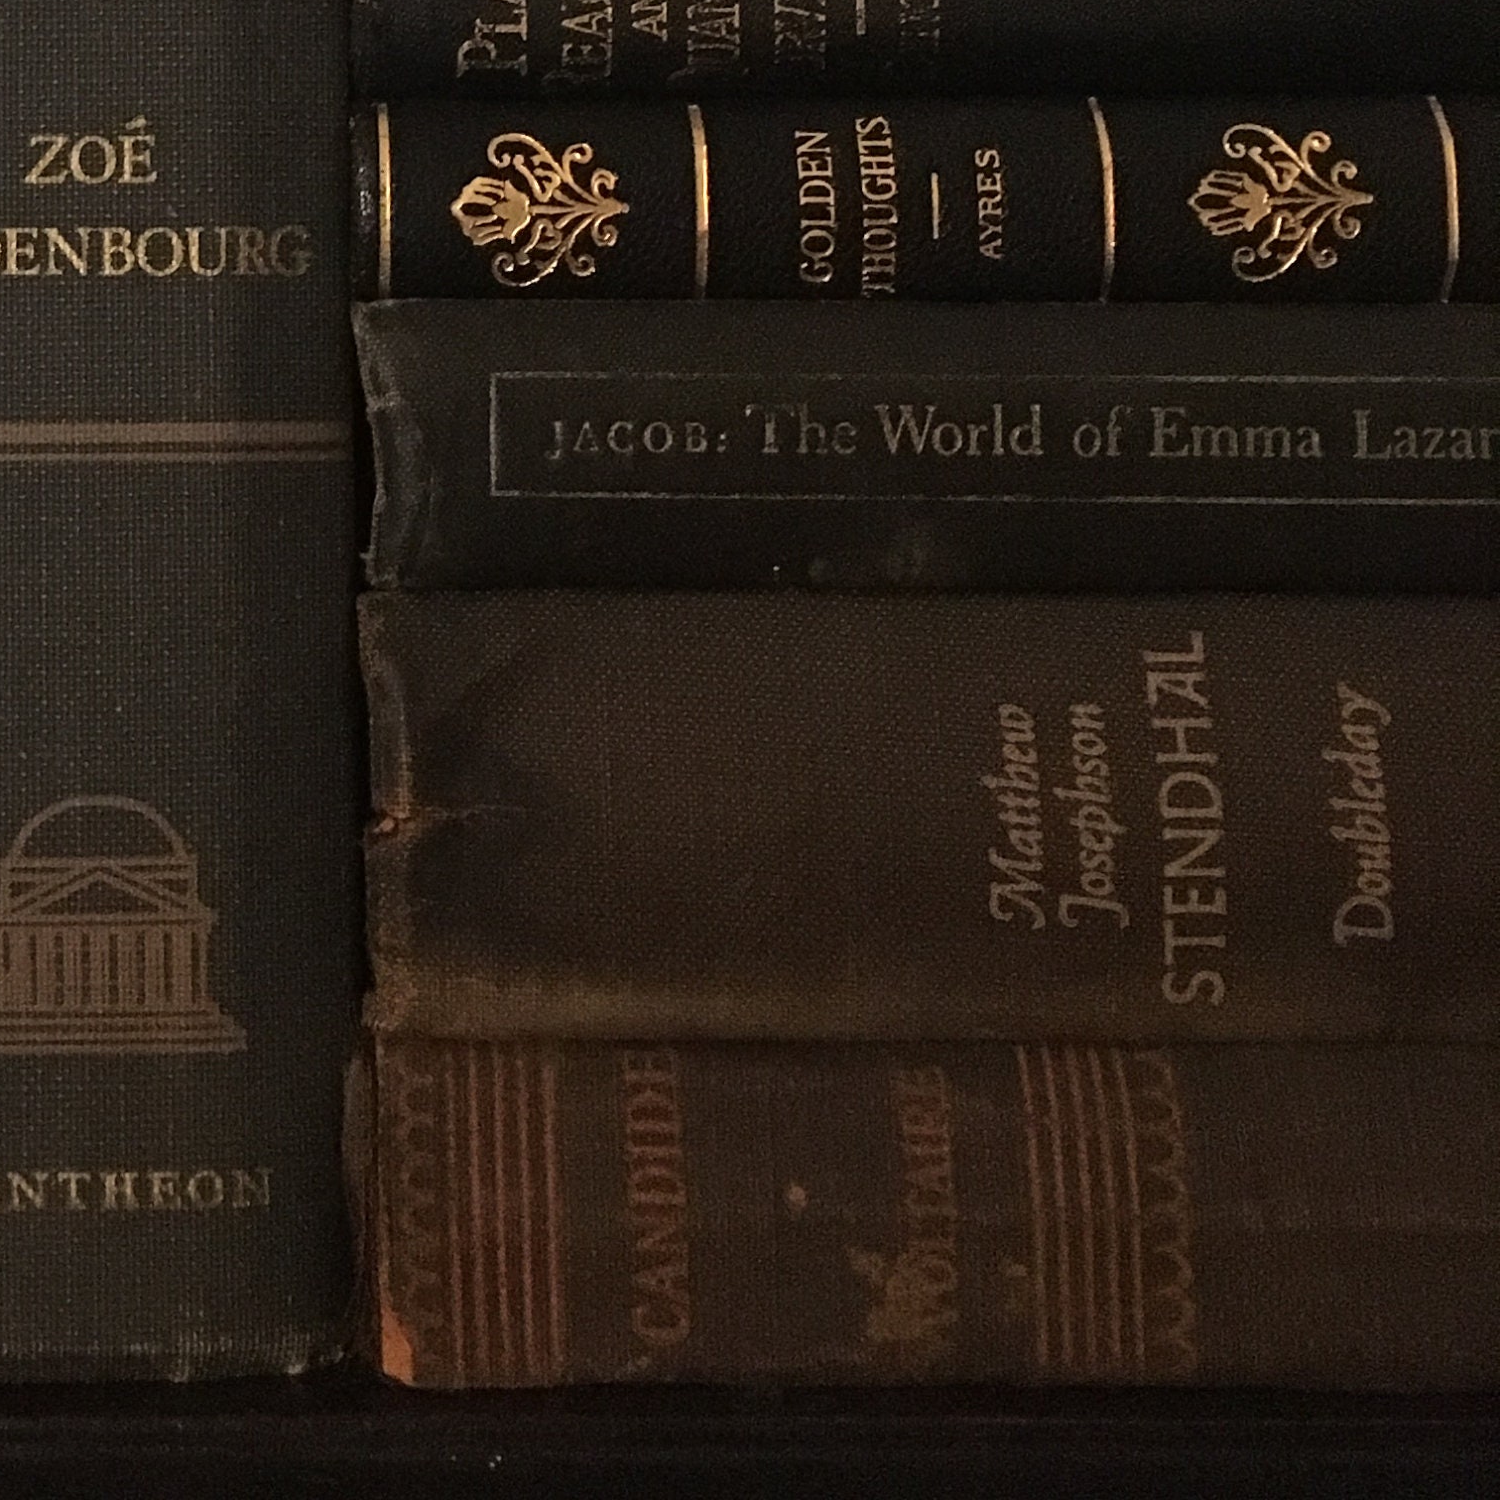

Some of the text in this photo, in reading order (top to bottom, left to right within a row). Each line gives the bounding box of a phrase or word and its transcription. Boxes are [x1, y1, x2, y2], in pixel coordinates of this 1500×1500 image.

[24, 116, 159, 185] ZOÉ
[794, 130, 837, 283] GOLDEN
[975, 149, 1004, 260] AYRES
[544, 401, 1500, 462] JACOB: The World of Emma Lazar
[981, 702, 1047, 930] Matthew
[1052, 702, 1131, 930] Josephson
[1140, 630, 1229, 1006] STENDHAL
[1321, 680, 1396, 947] Doubleday
[623, 1049, 692, 1345] CANDIDE
